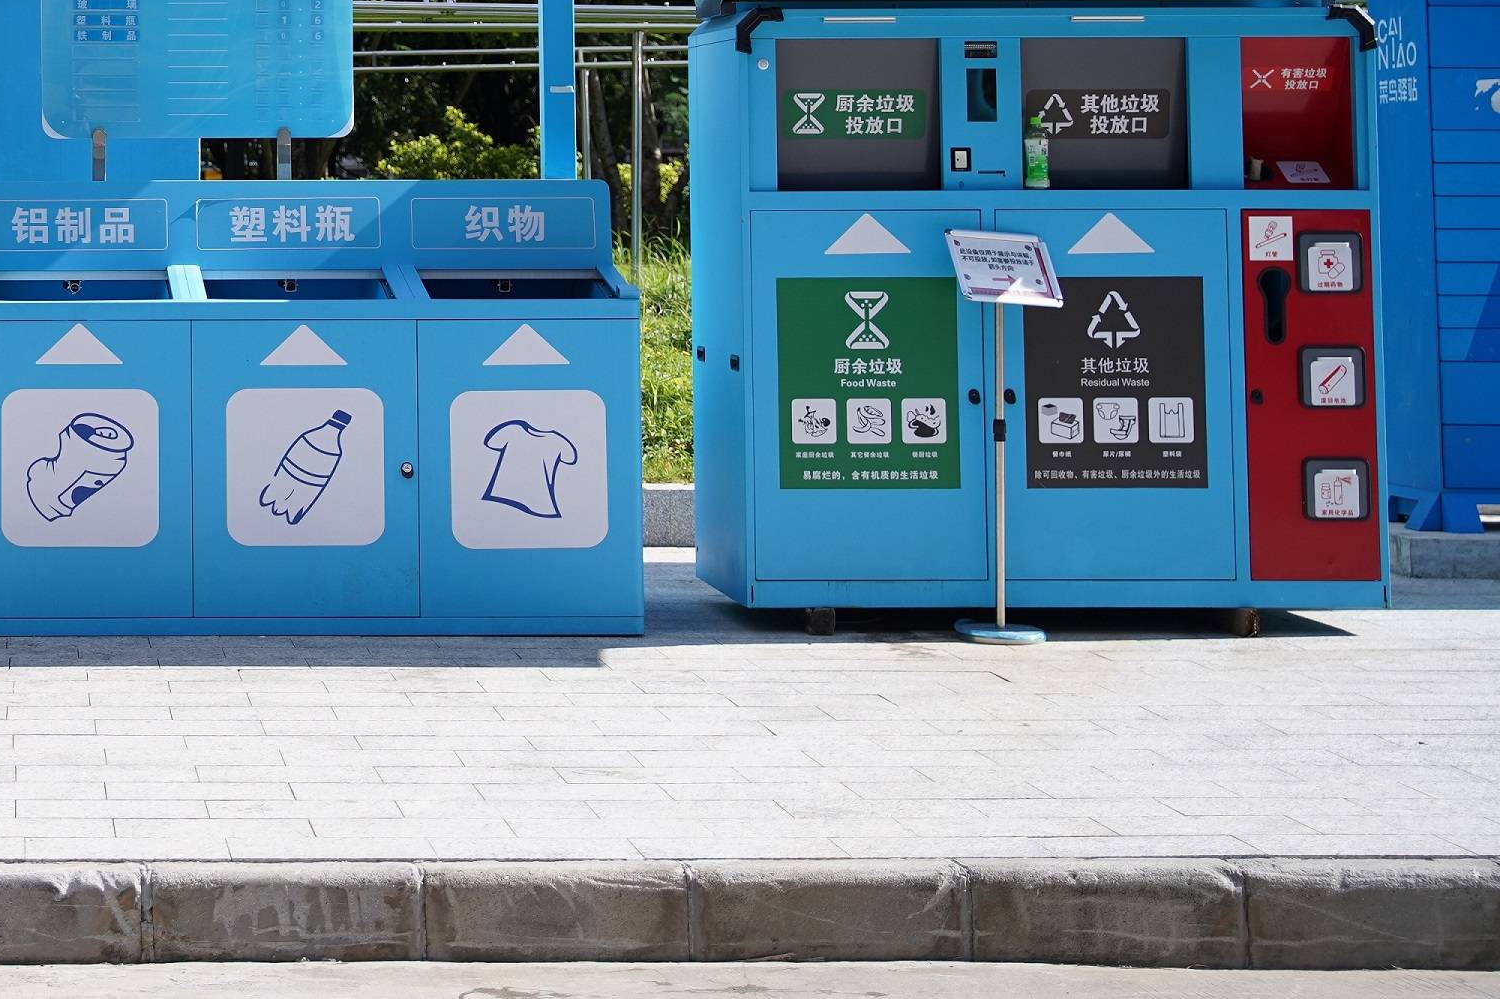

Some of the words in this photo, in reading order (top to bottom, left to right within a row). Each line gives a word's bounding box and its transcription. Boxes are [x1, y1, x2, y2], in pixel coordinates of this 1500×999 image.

[77, 0, 137, 10] 玻璃
[77, 15, 136, 26] 塑料瓶
[1281, 68, 1327, 79] 有害垃圾
[1284, 80, 1319, 90] 投放口
[1379, 76, 1418, 105] 菜鸟驿站
[835, 93, 915, 114] 厨余垃圾
[1080, 93, 1160, 114] 其他垃圾
[845, 116, 903, 135] 投放口
[1090, 115, 1148, 135] 投放口
[11, 206, 136, 245] 铝制品
[228, 205, 356, 244] 塑料瓶
[464, 204, 546, 244] 织物
[834, 358, 903, 375] 厨余垃圾
[1081, 357, 1150, 374] 其他垃圾
[840, 379, 865, 388] Food
[866, 379, 897, 388] Waste
[1081, 378, 1120, 387] Residual
[1122, 378, 1150, 387] Waste
